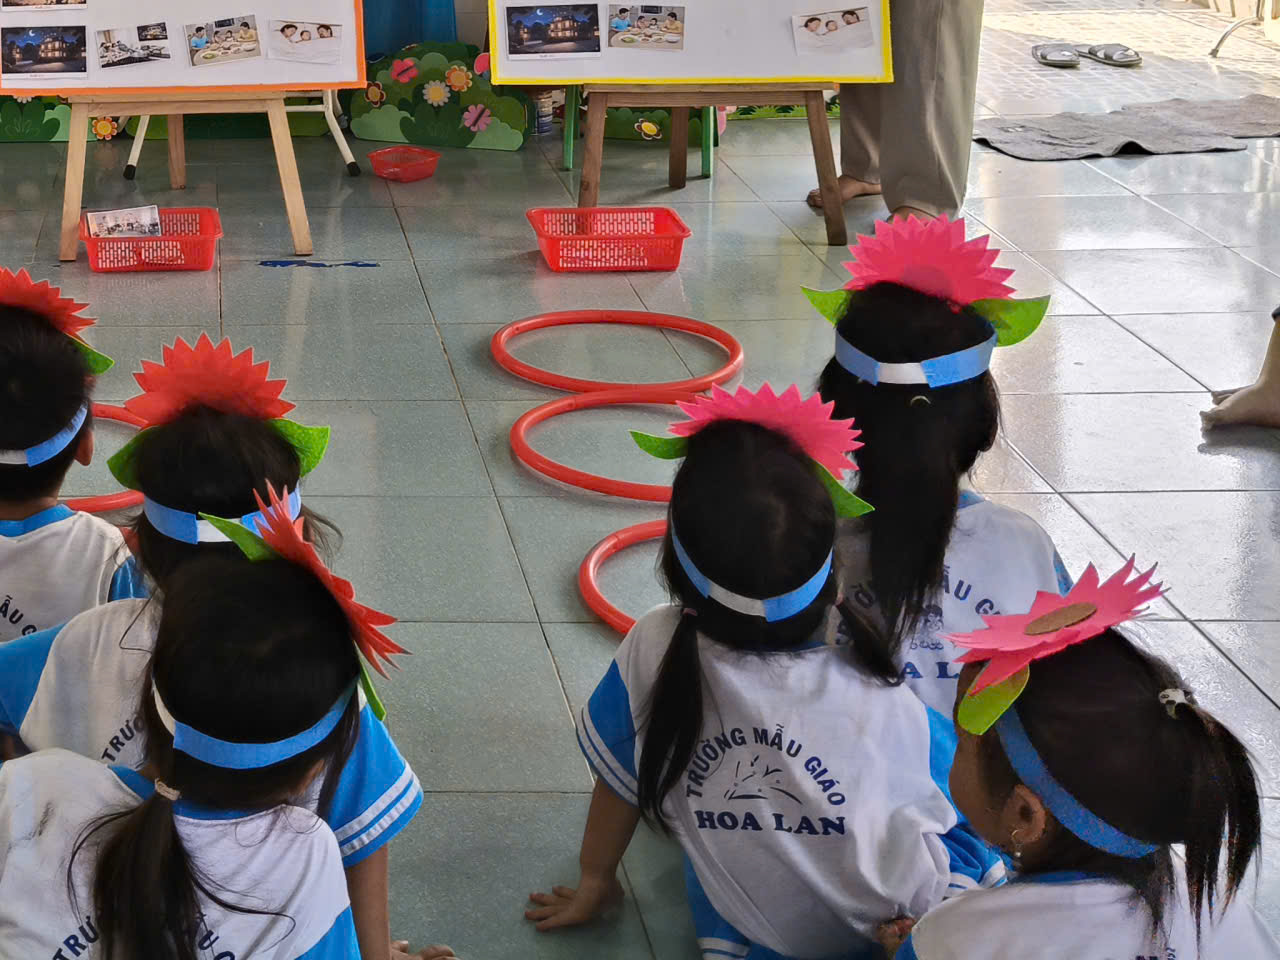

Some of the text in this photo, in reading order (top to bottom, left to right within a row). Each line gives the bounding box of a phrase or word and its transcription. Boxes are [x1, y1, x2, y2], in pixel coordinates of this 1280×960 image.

[686, 723, 846, 806] TRƯỜNG MẪU GIÁO
[694, 809, 846, 835] HOA LAN
